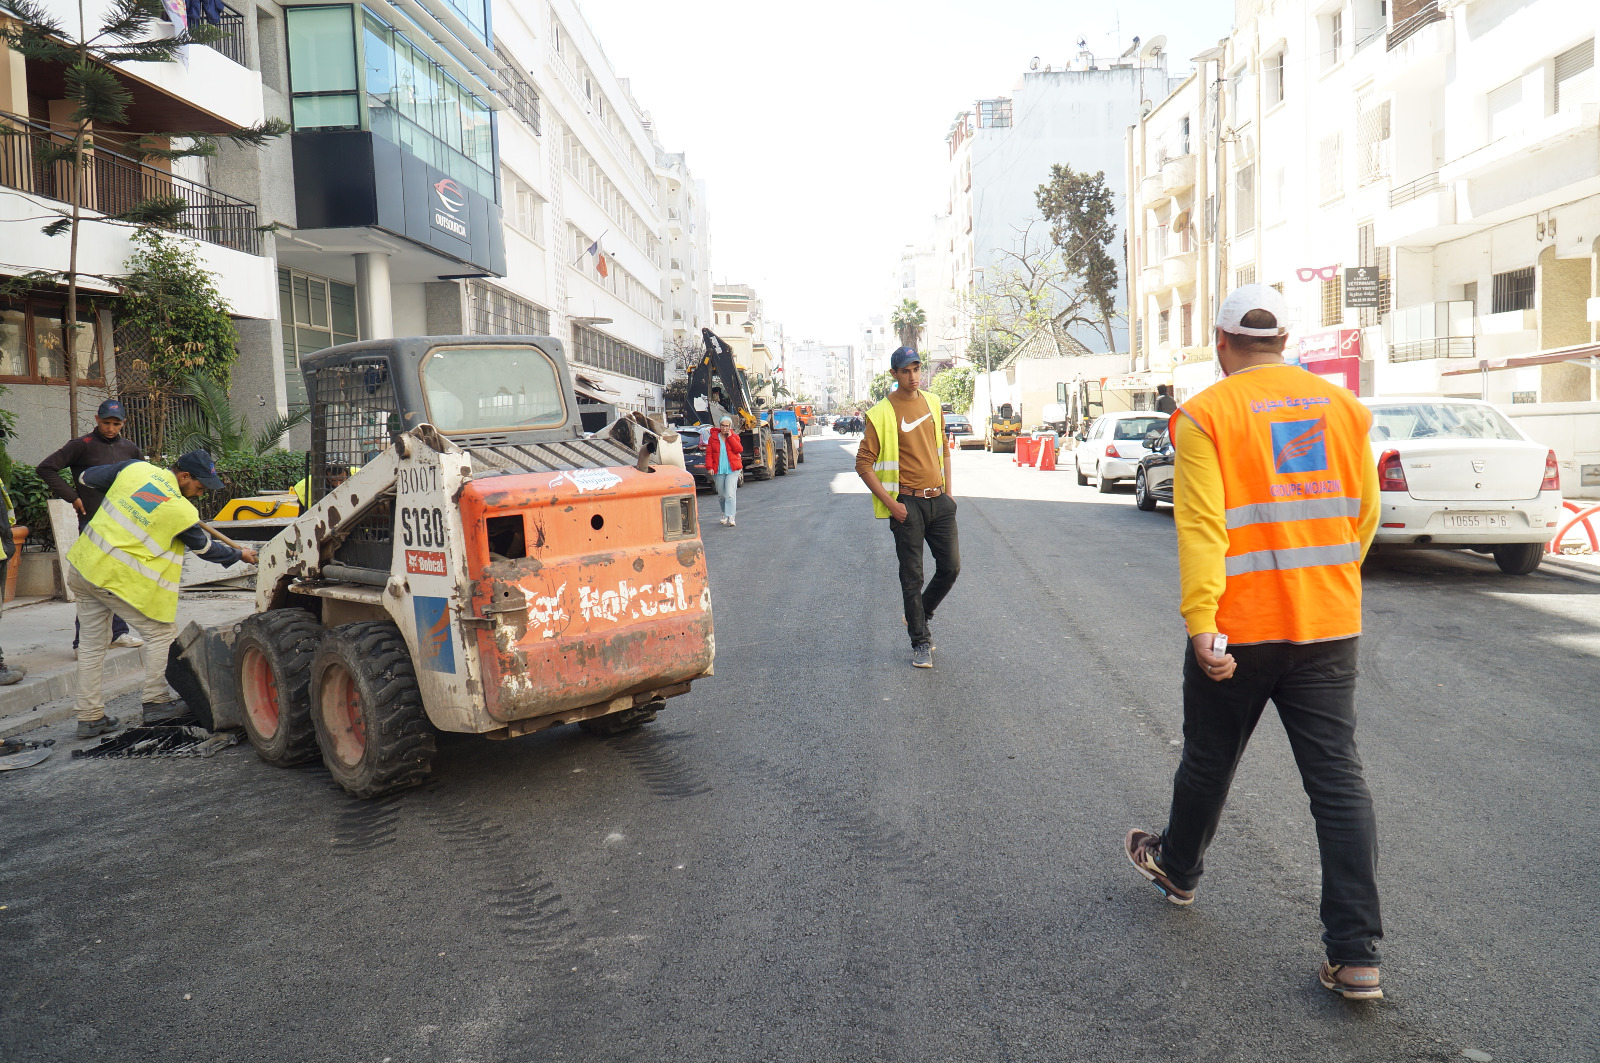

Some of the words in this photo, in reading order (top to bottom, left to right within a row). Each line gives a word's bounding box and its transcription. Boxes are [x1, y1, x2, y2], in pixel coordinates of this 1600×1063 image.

[435, 213, 467, 237] OUTSOURCIA
[1285, 396, 1331, 410] مجموعة
[1270, 483, 1302, 497] GROUPE
[401, 507, 445, 548] S130
[1451, 515, 1480, 527] 10655
[1500, 515, 1507, 527] 6
[418, 556, 446, 573] Bobcat
